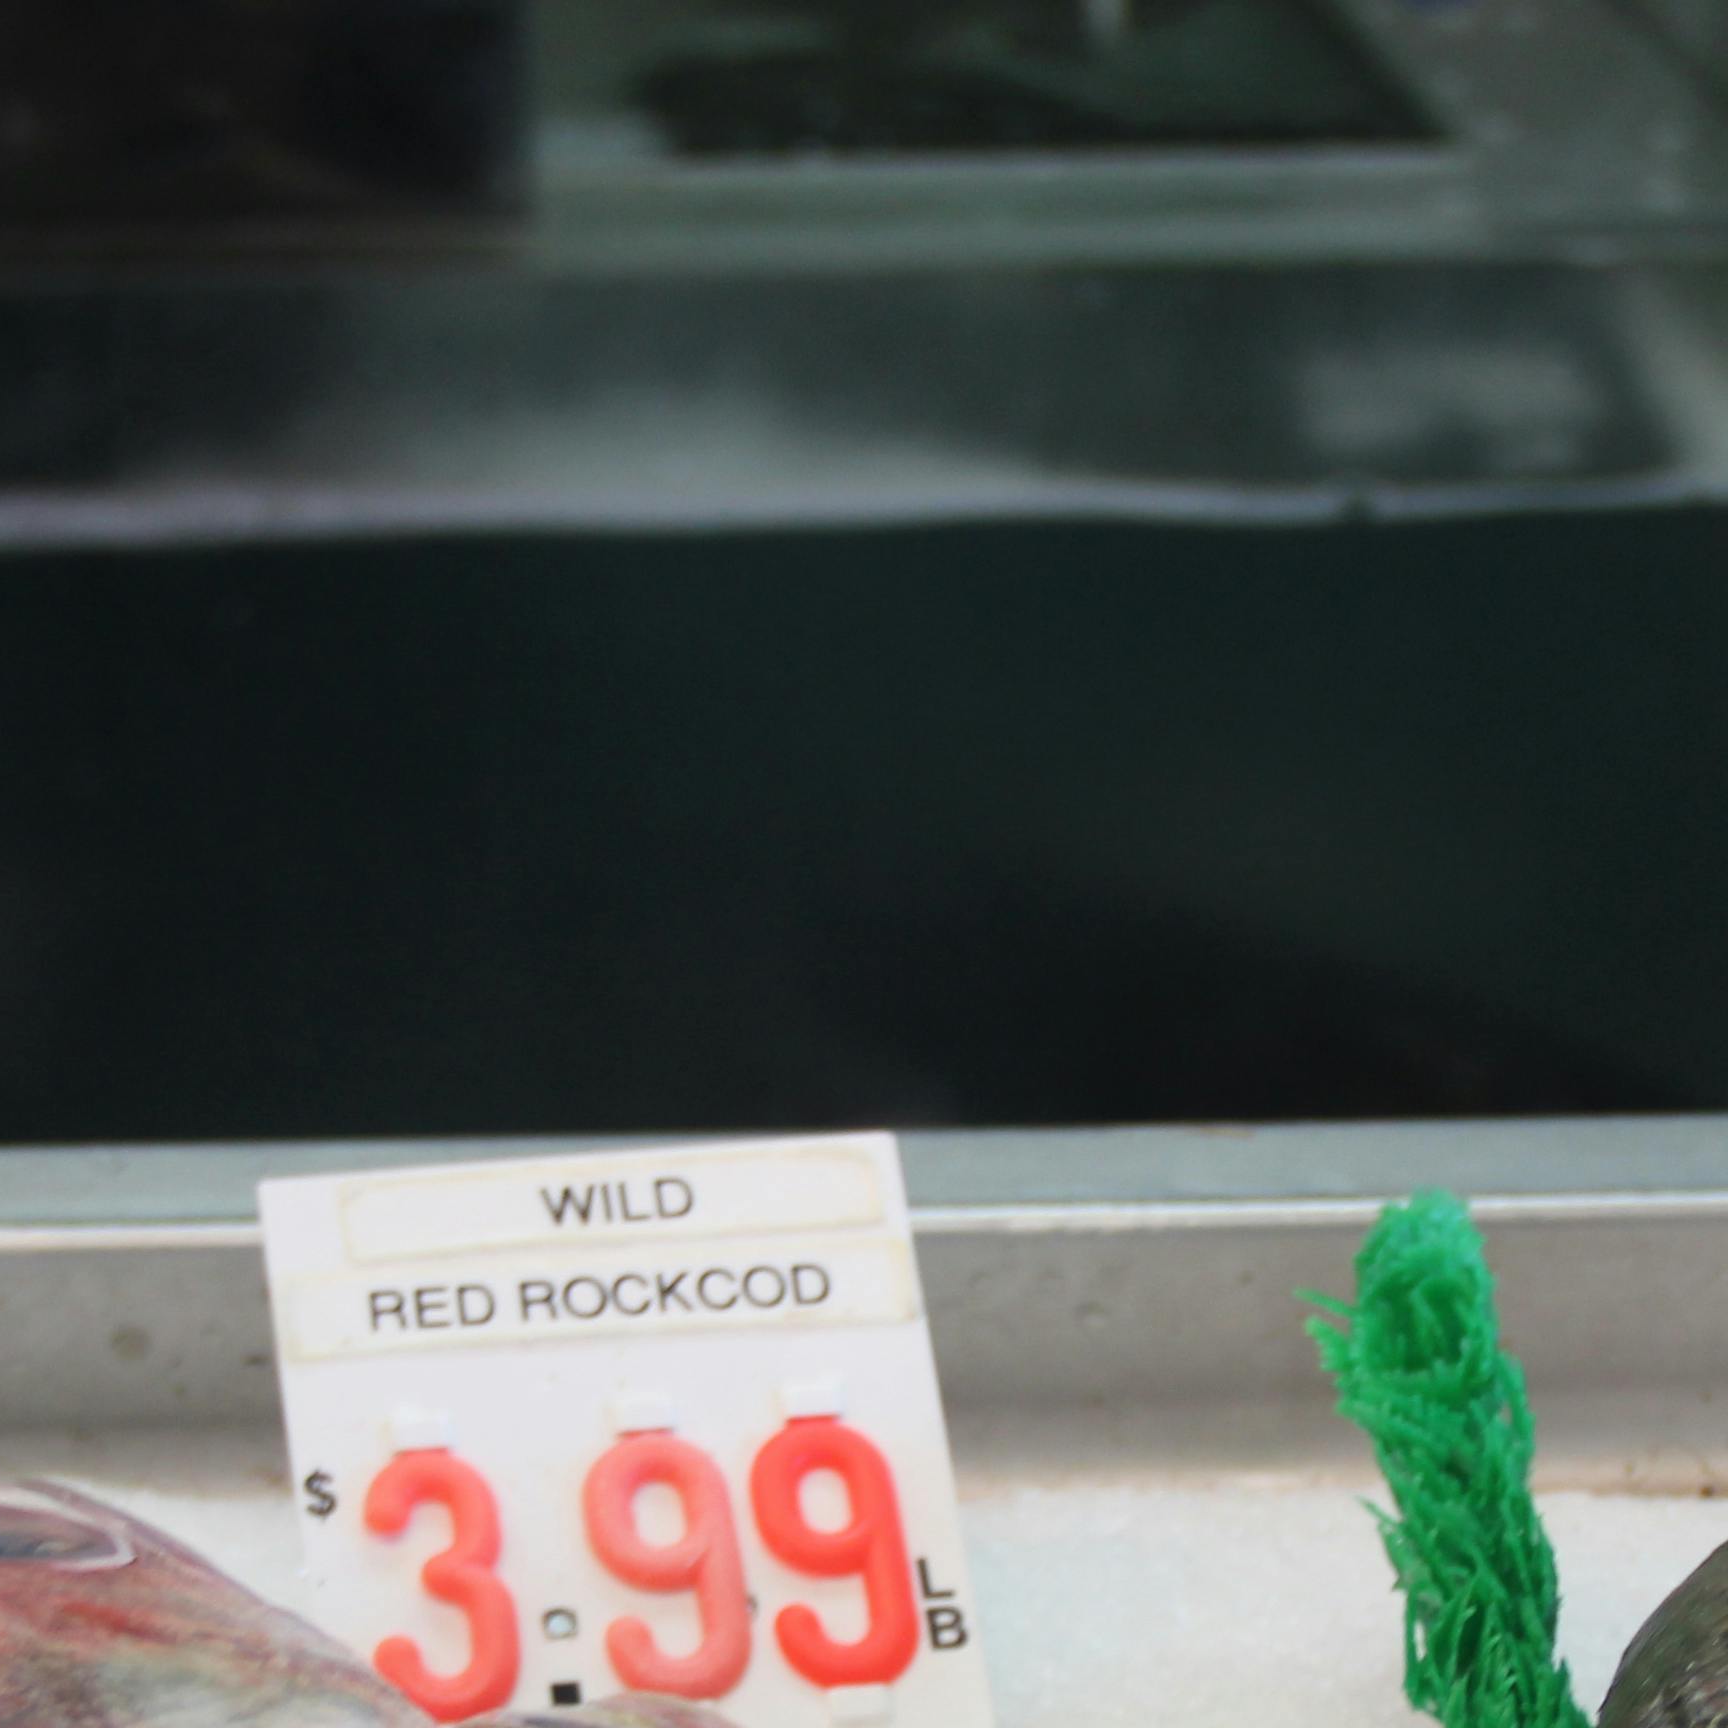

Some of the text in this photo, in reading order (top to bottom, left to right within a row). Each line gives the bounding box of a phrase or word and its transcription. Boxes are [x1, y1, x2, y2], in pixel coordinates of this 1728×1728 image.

[540, 1177, 693, 1225] WILD
[368, 1263, 832, 1332] RED ROCKCOD
